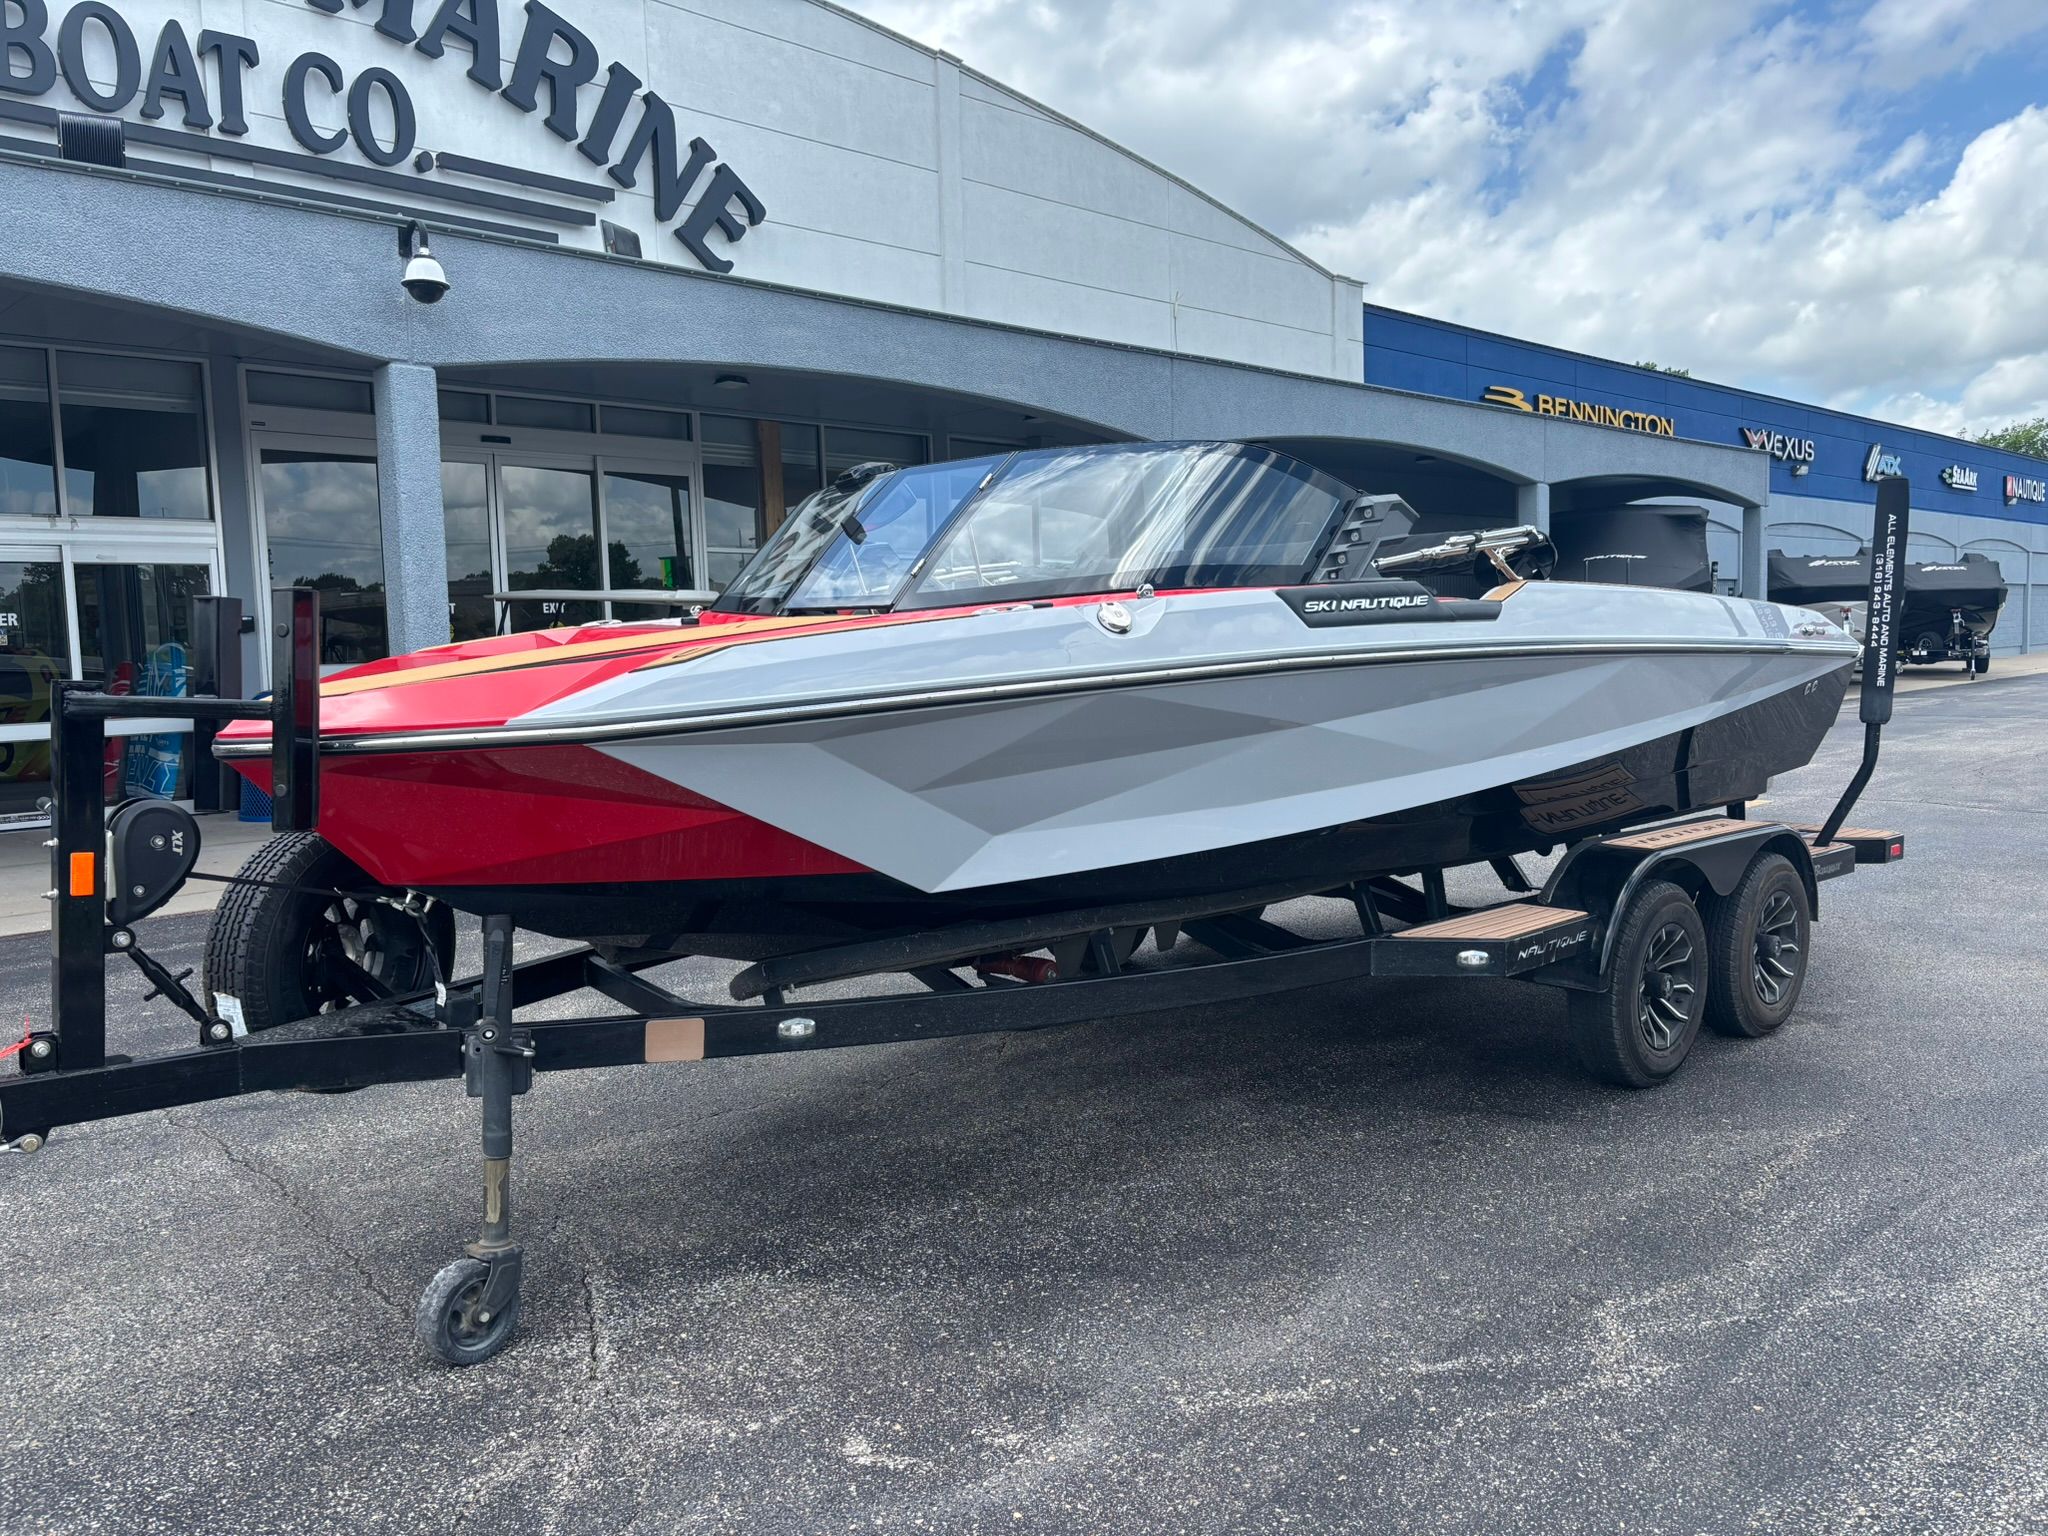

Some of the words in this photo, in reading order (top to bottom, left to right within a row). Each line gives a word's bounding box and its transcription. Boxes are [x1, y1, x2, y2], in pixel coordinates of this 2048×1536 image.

[0, 0, 259, 135] BOAT
[283, 52, 434, 173] CO.
[1538, 394, 1675, 437] BENNINGTON
[1762, 429, 1815, 461] VEXUS
[1877, 455, 1902, 475] ATX
[2012, 477, 2046, 502] NAUTIQUE
[1887, 513, 1897, 534] ALL
[1883, 536, 1896, 592] ELEMENTS
[1304, 600, 1337, 613] SKI
[1340, 595, 1429, 610] NAUTIQUE
[1881, 593, 1892, 623] AUTO
[1880, 624, 1890, 646] AND
[1876, 648, 1888, 687] MARINE
[171, 829, 184, 857] XLT
[1517, 930, 1588, 961] NAUTIQUE
